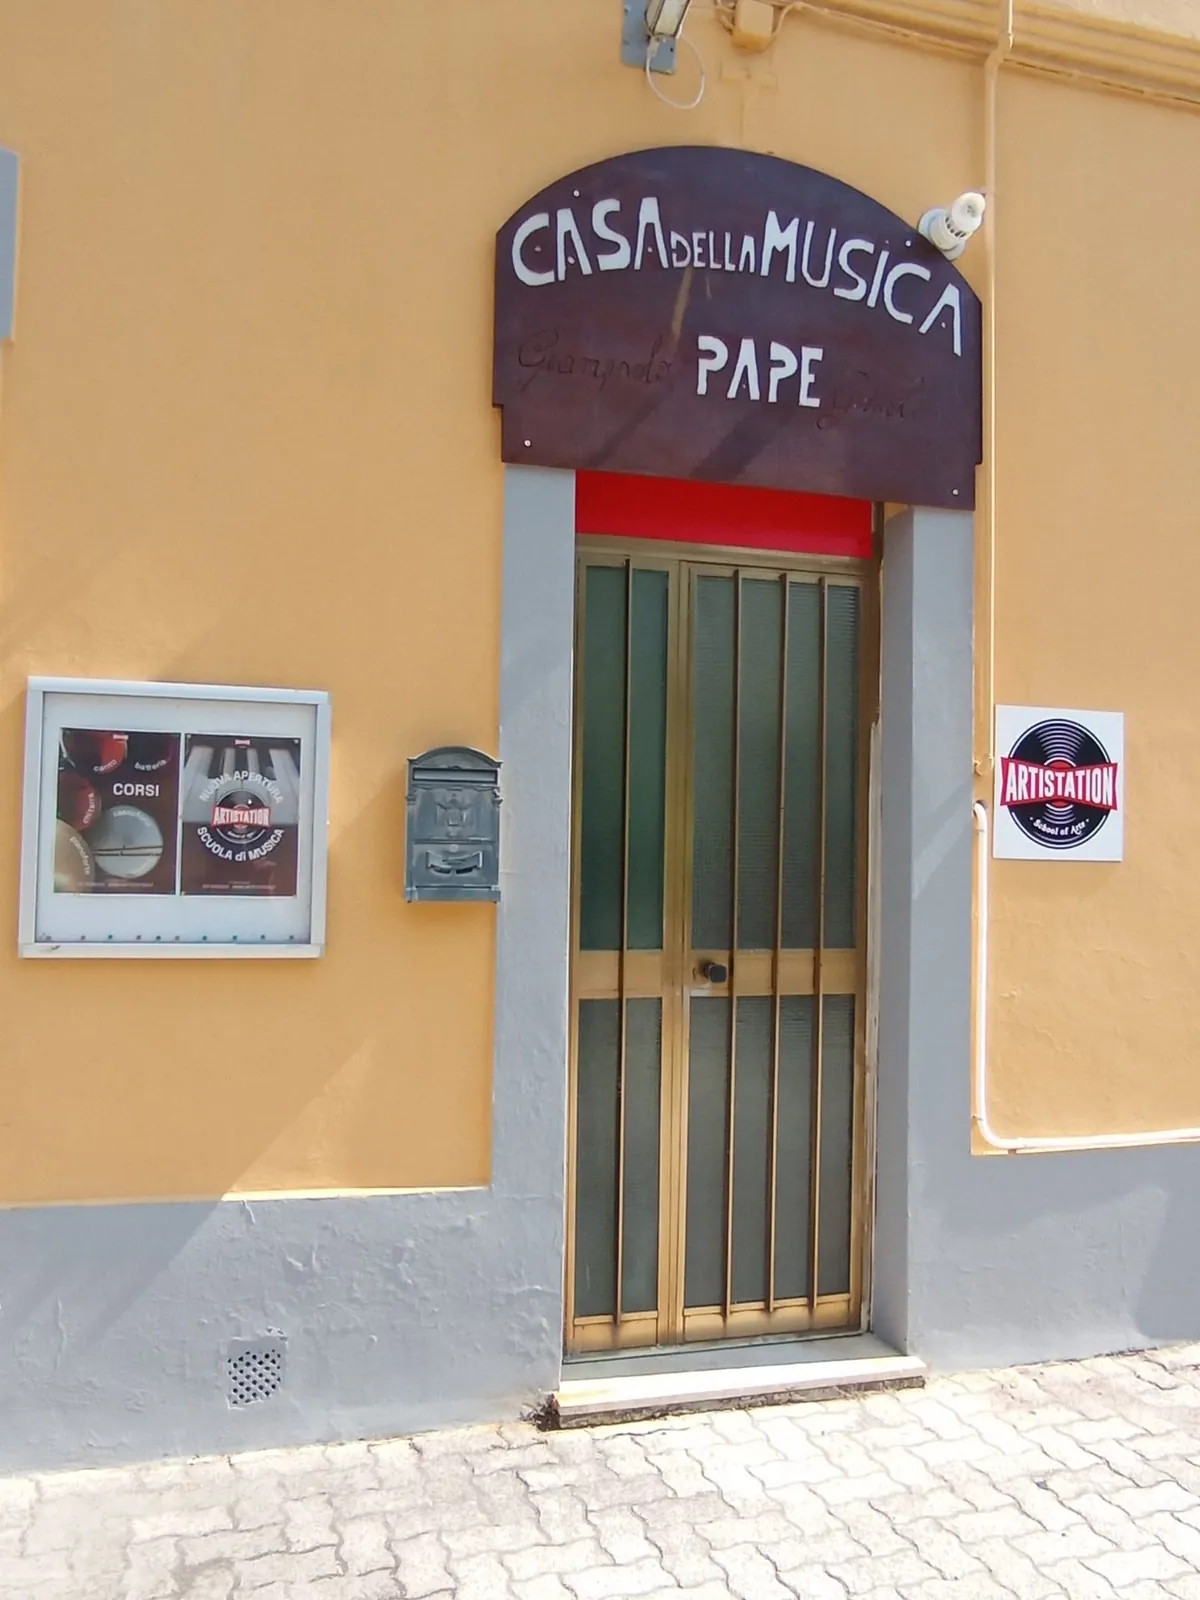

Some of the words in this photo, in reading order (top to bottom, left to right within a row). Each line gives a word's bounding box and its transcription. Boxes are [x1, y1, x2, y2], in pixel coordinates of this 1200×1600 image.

[512, 197, 669, 286] CASA
[671, 230, 756, 273] DELLA
[761, 210, 962, 357] MUSICA
[696, 335, 824, 408] PAPE
[113, 783, 160, 797] CORSI
[199, 774, 232, 802] NUOVA
[233, 770, 284, 804] APERTURA
[1006, 762, 1113, 806] ARTISTATION
[197, 826, 233, 860] SCUOLA
[235, 852, 246, 861] di
[248, 828, 285, 860] MUSICA
[1033, 819, 1059, 835] School
[1060, 826, 1069, 836] of
[1070, 820, 1086, 835] Arts
